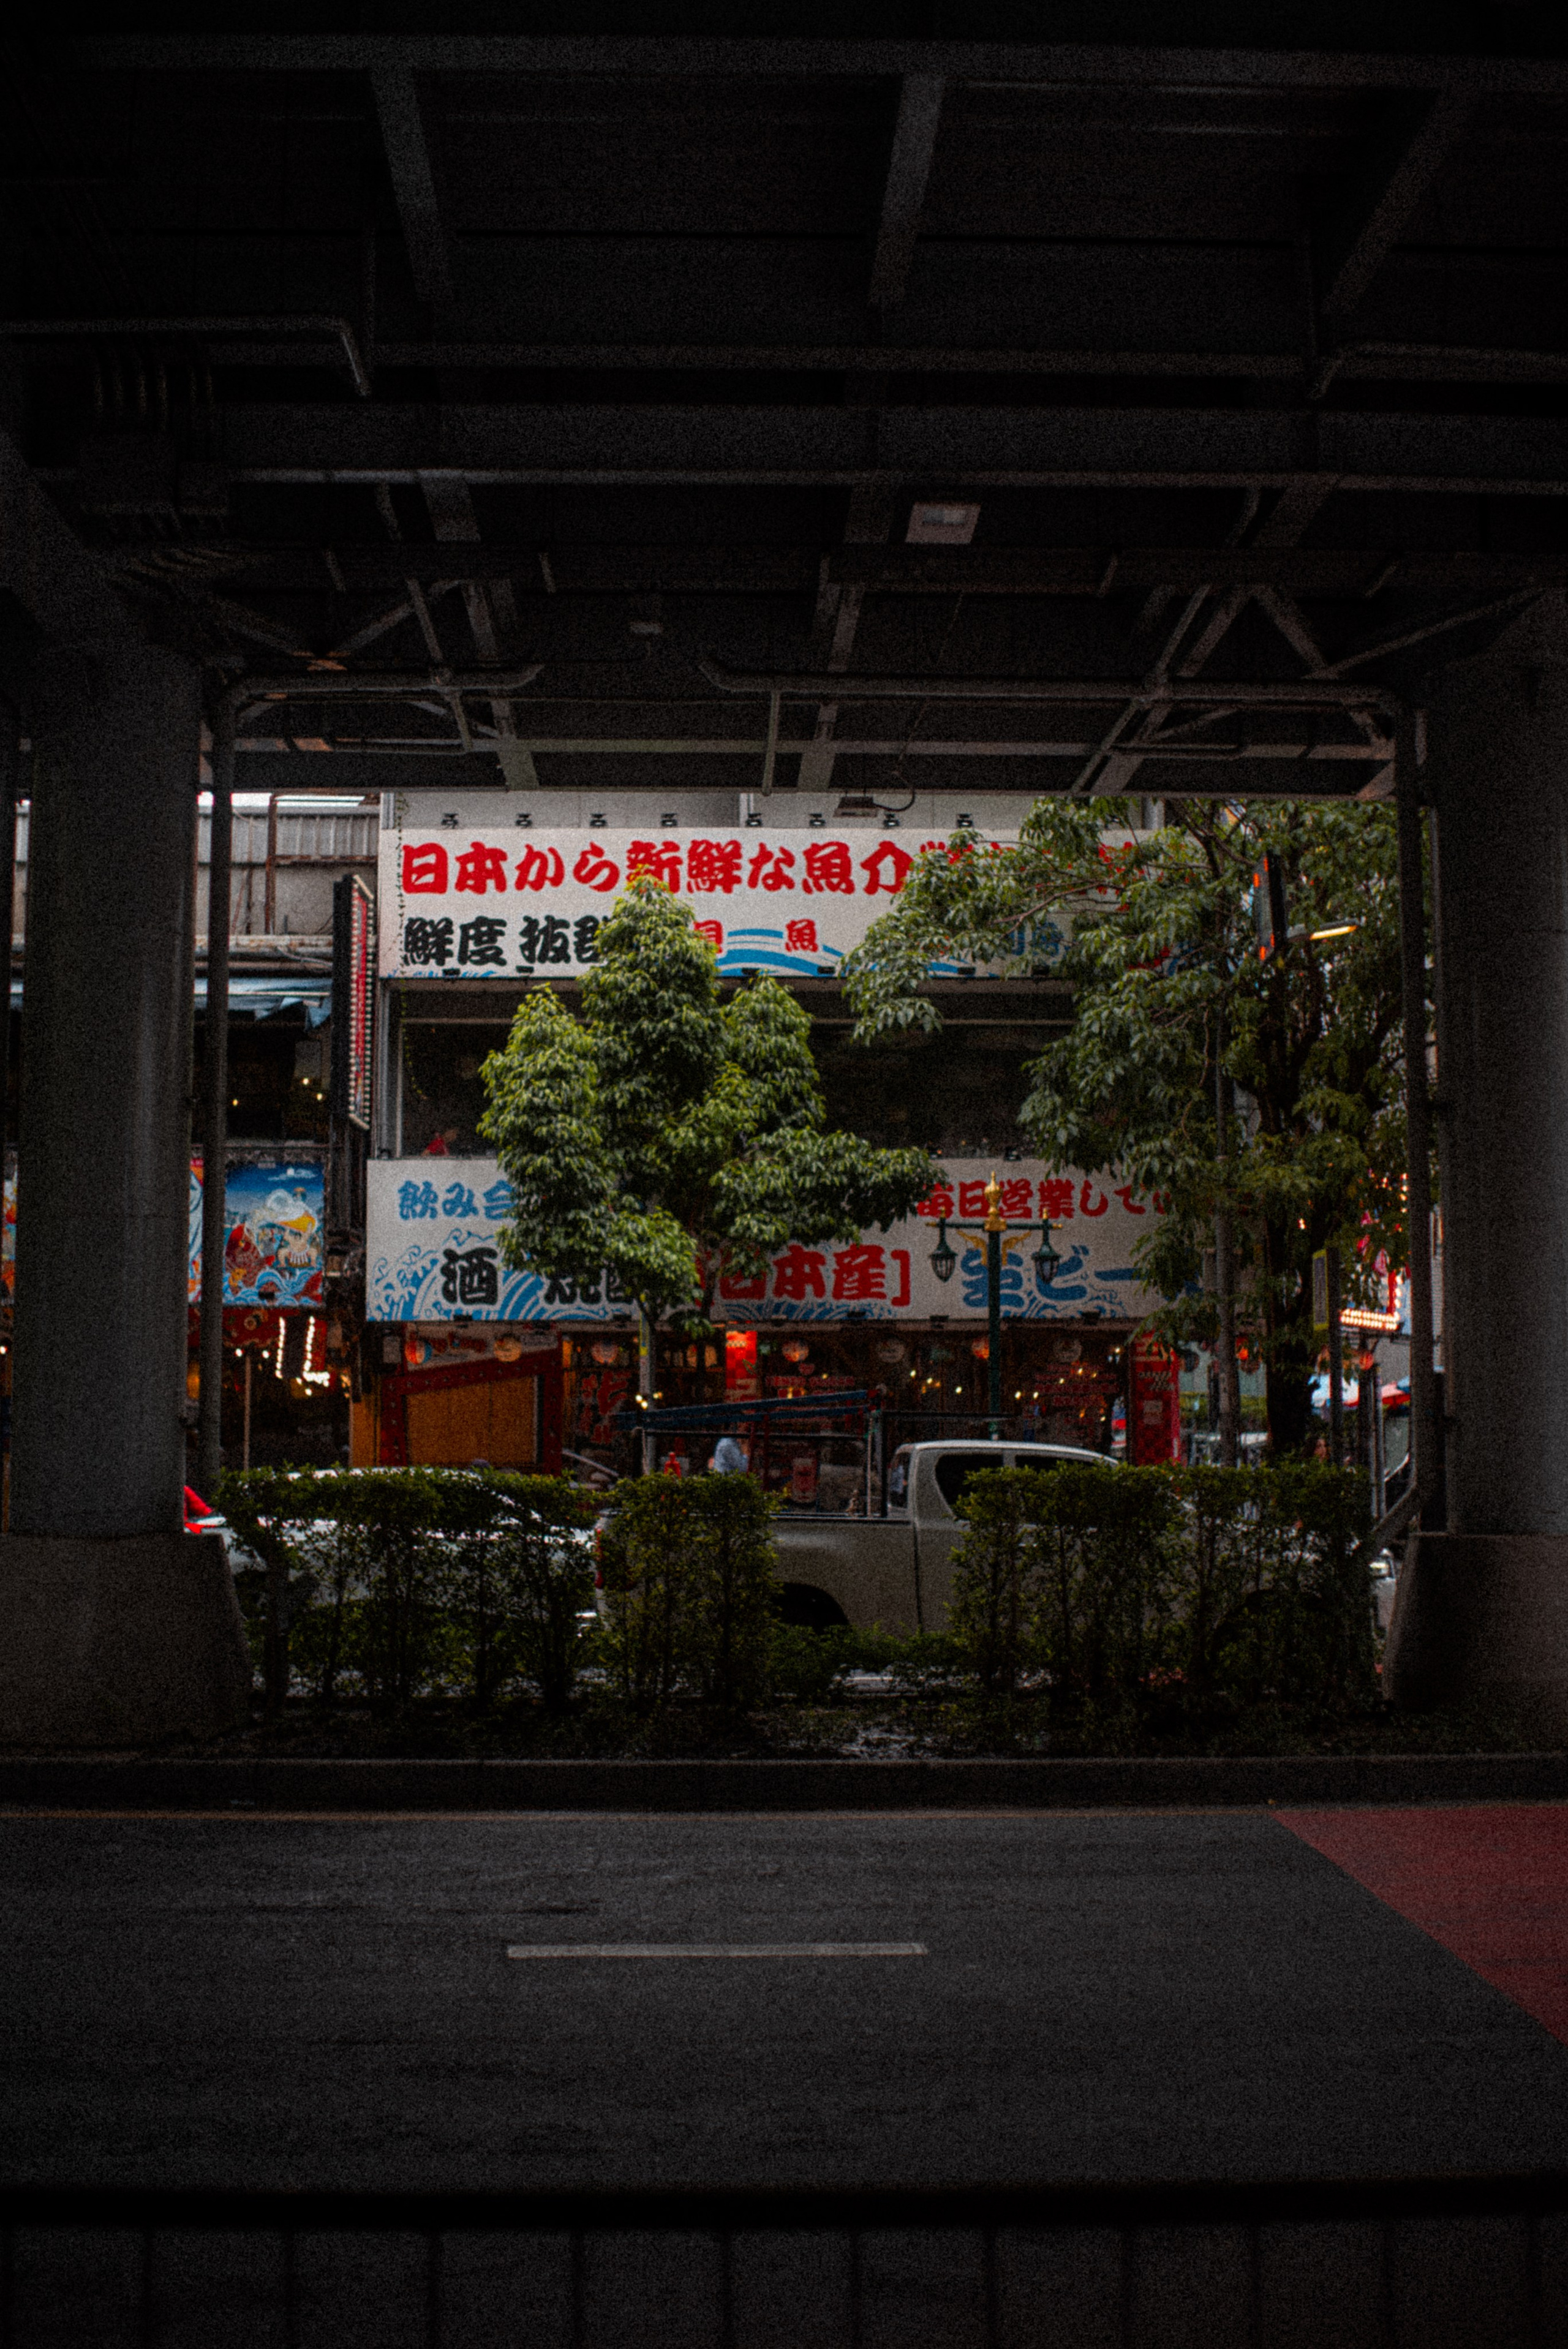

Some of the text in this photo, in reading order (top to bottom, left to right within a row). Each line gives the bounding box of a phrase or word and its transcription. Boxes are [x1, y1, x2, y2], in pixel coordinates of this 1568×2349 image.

[402, 840, 1191, 895] 日本から新鮮な魚介
[785, 919, 819, 952] 魚
[440, 1246, 499, 1305] 酒
[960, 1244, 1204, 1308] 生ビー
